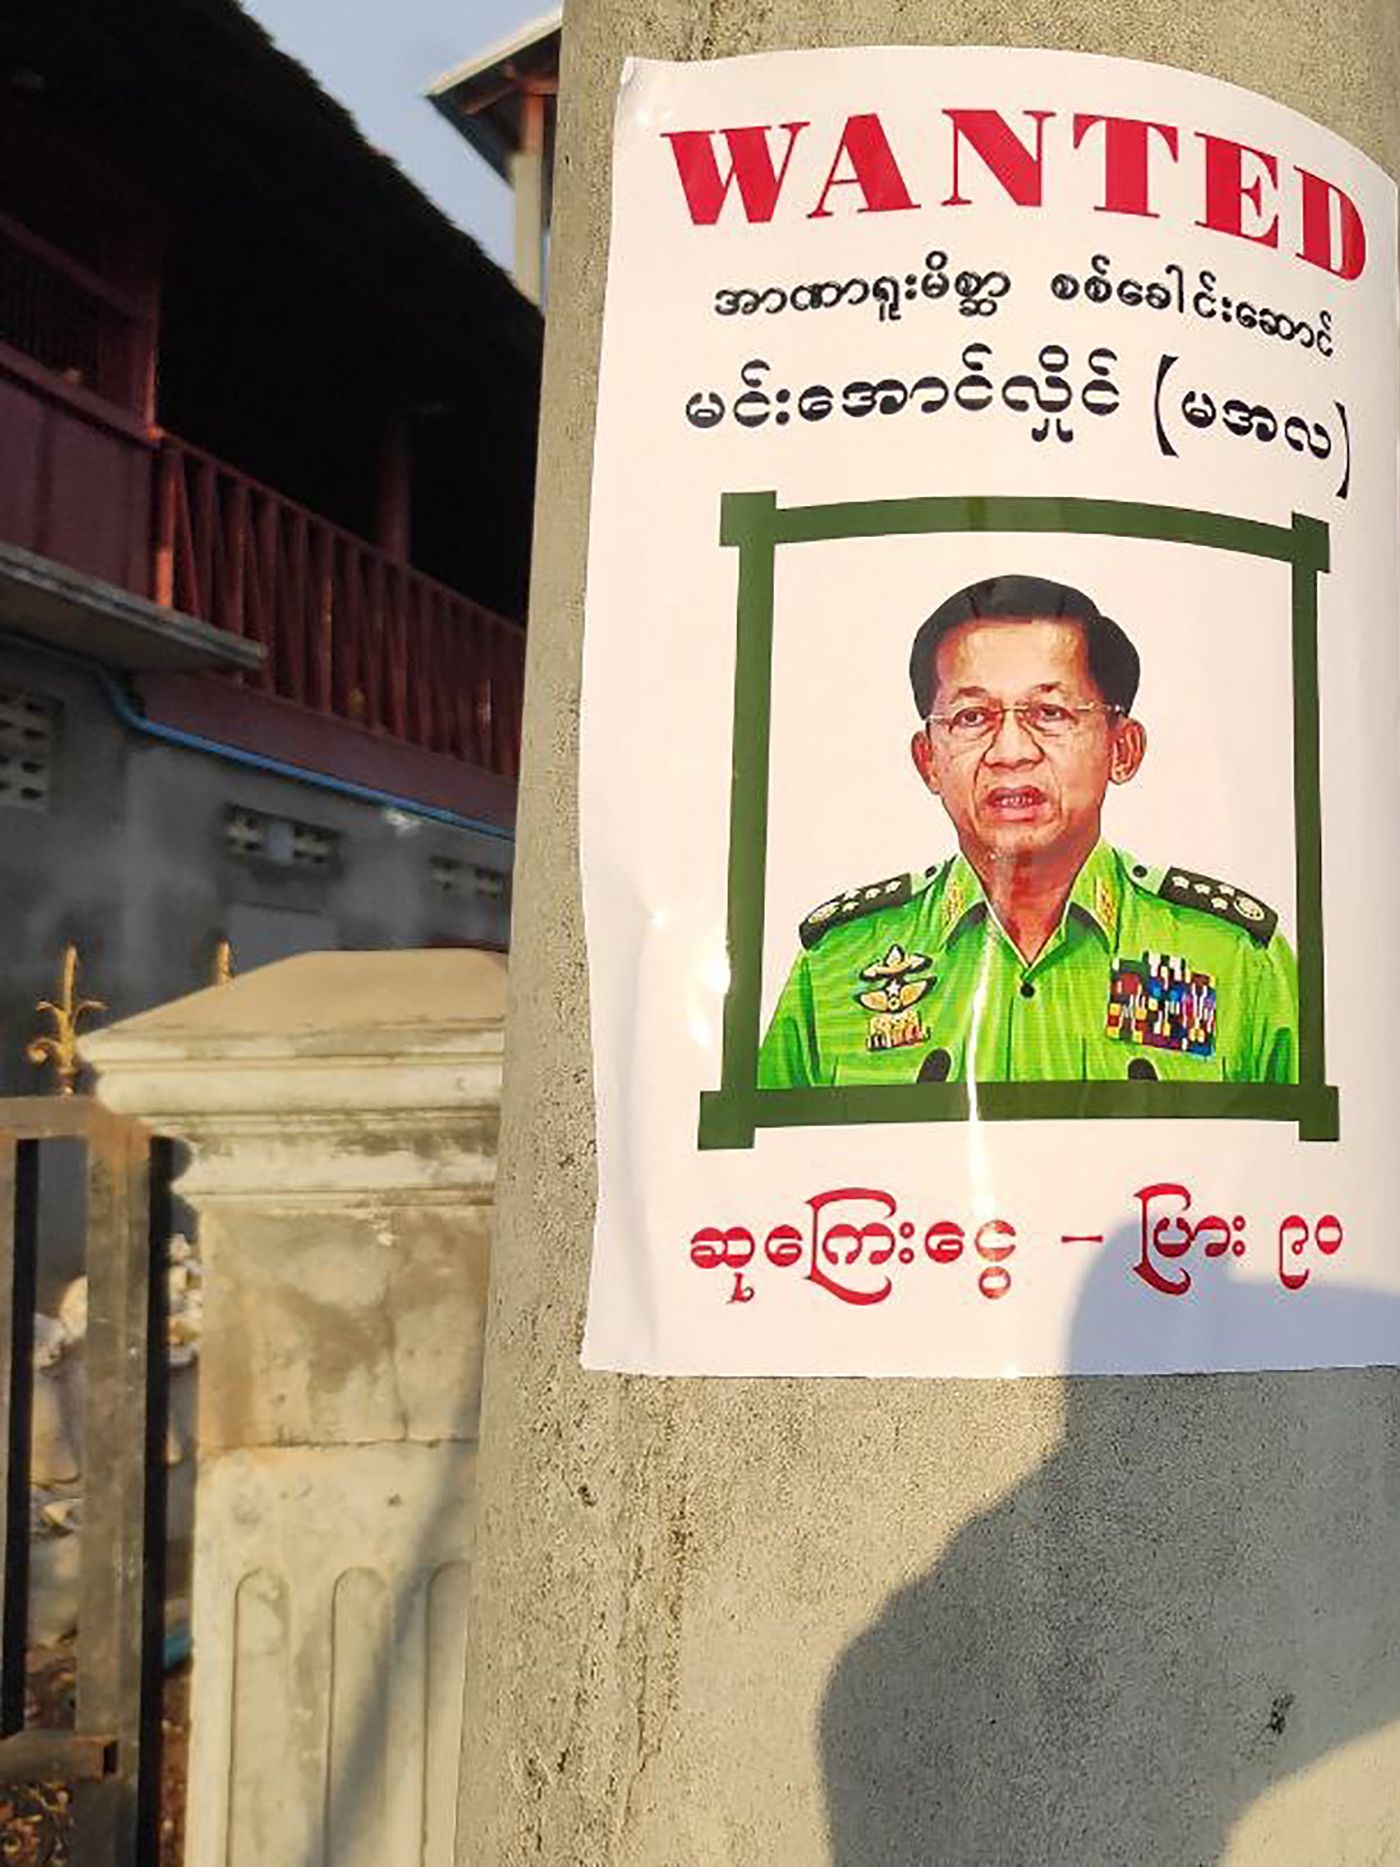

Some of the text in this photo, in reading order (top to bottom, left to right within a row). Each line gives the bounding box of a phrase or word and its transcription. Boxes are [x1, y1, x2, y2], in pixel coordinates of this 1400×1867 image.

[660, 107, 1367, 282] WANTED
[713, 250, 1333, 358] အာဏာရူးမိစ္ဆာ စစ်ခေါင်းဆောင်
[685, 342, 1351, 500] မင်းအောင်လှိုင် (မအလ)
[688, 1187, 1017, 1307] ဆုကြေးငွေ
[1134, 1181, 1248, 1297] ပြား
[1277, 1213, 1346, 1291] ၉၀
